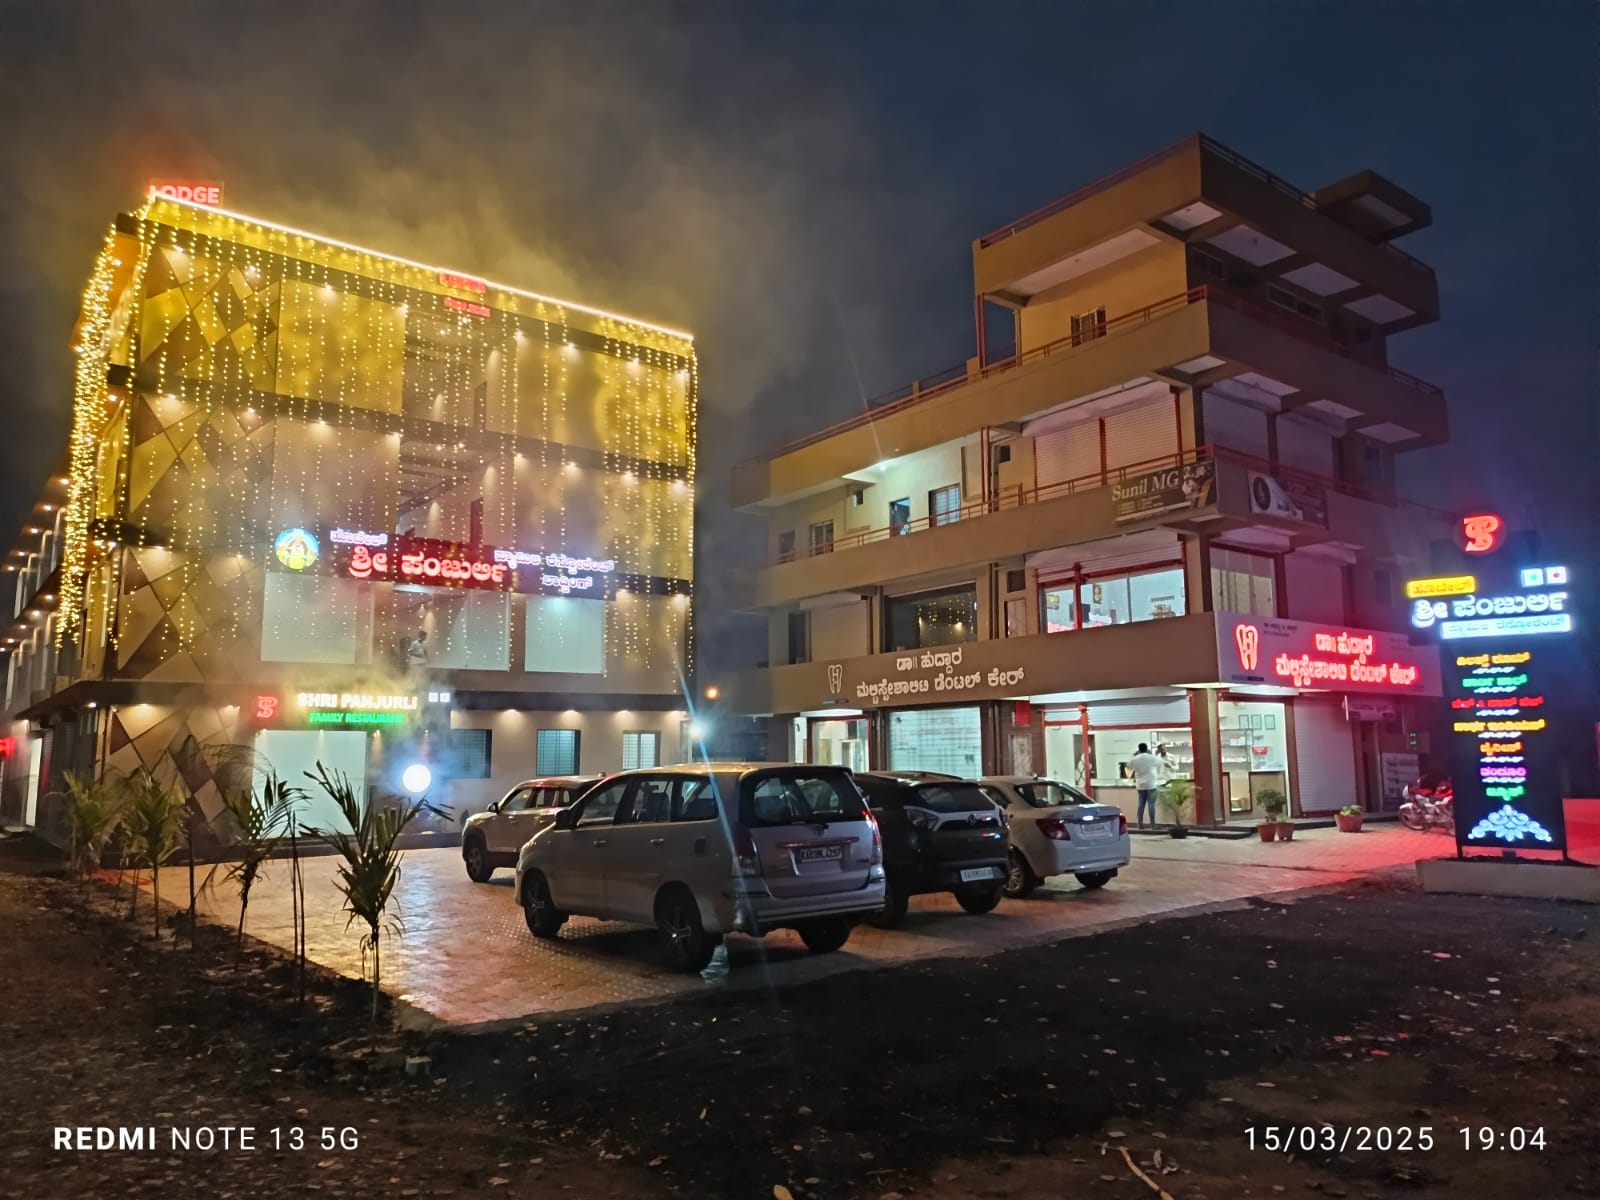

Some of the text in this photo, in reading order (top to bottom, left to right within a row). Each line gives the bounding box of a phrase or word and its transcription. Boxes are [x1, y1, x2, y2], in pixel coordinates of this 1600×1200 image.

[1112, 470, 1179, 501] Sunil MG
[348, 545, 388, 577] ಶ್ರೀ
[1412, 598, 1449, 628] ಶ್ರೀ
[934, 672, 981, 691] ಡೆಂಟಲ್
[987, 667, 1025, 686] ಕೇರ್
[299, 693, 337, 708] SHRI
[310, 712, 404, 724] FAMILY RESTAURANT
